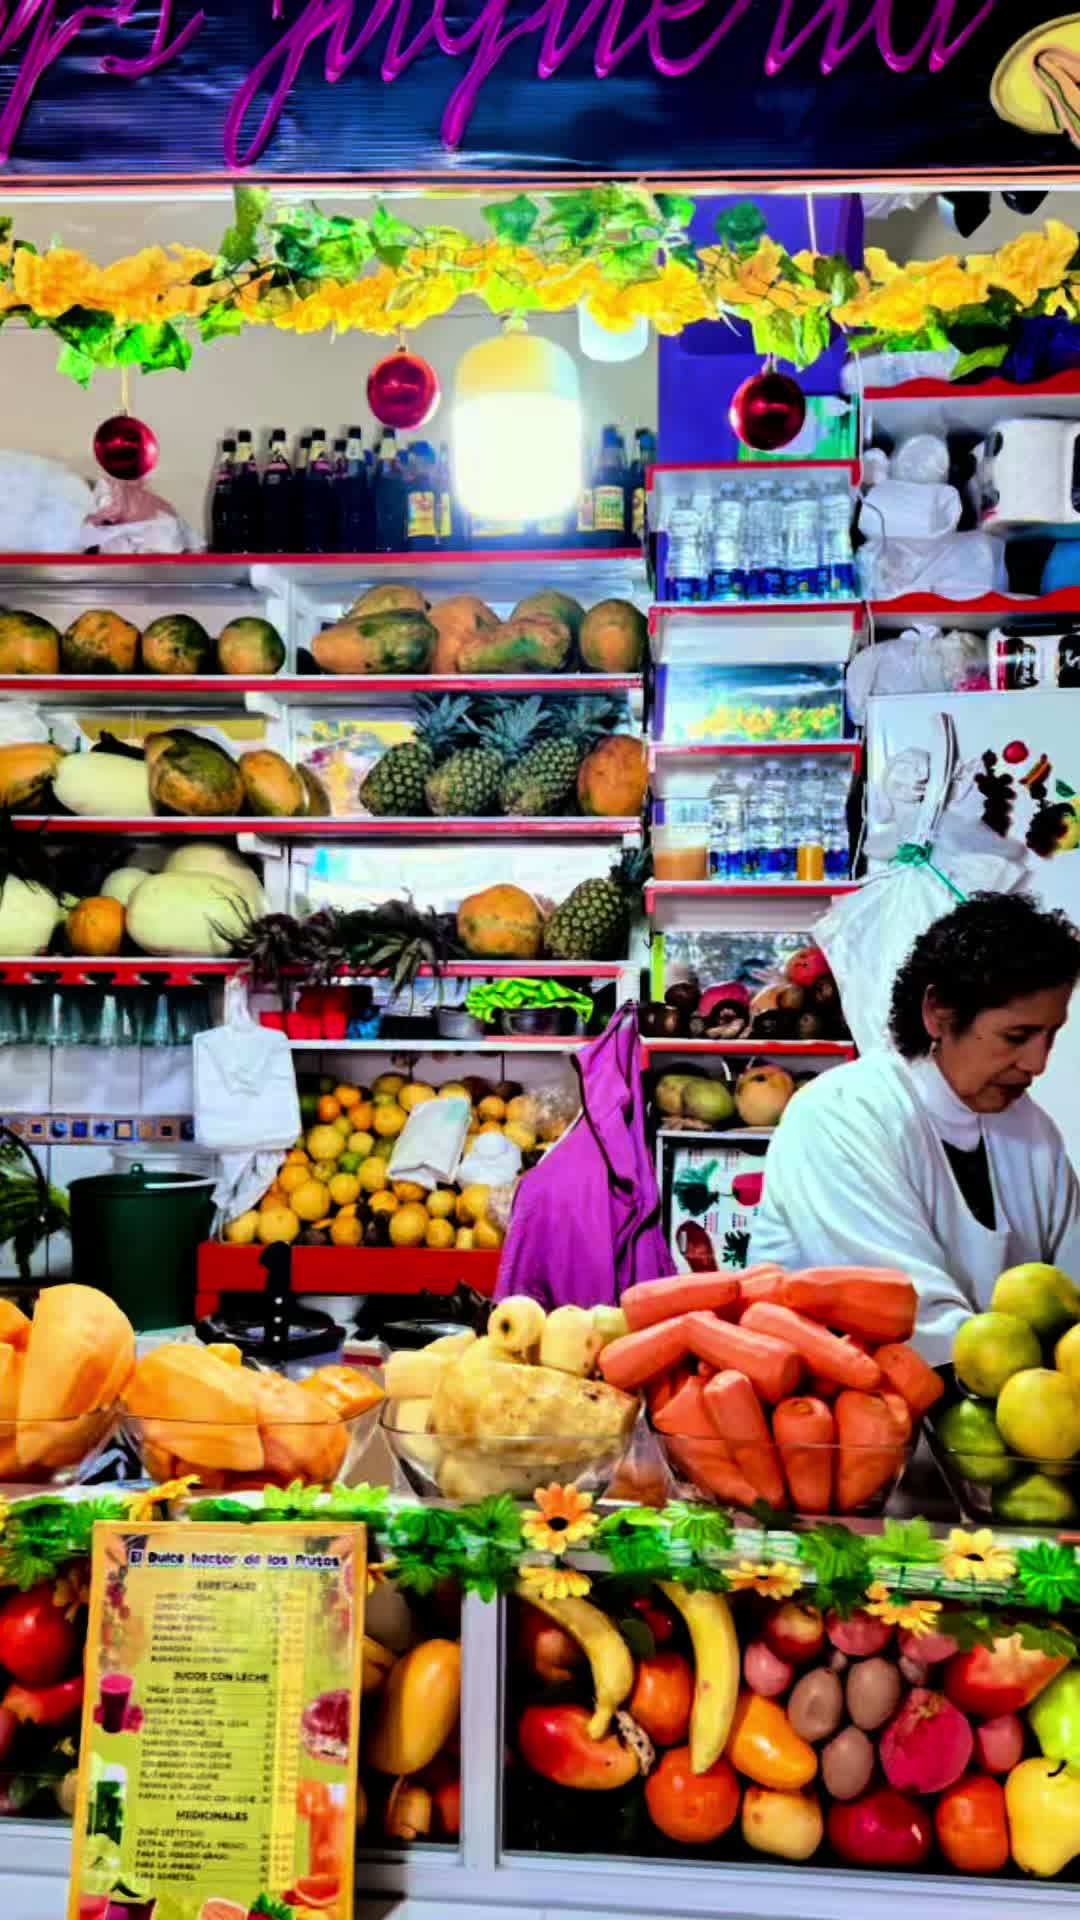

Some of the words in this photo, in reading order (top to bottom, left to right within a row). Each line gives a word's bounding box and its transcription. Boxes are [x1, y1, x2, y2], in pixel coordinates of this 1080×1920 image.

[130, 1551, 143, 1563] El
[148, 1551, 184, 1564] Dulce
[210, 1672, 233, 1681] CON
[235, 1672, 270, 1683] LECHE
[175, 1810, 249, 1822] MEDICINALES
